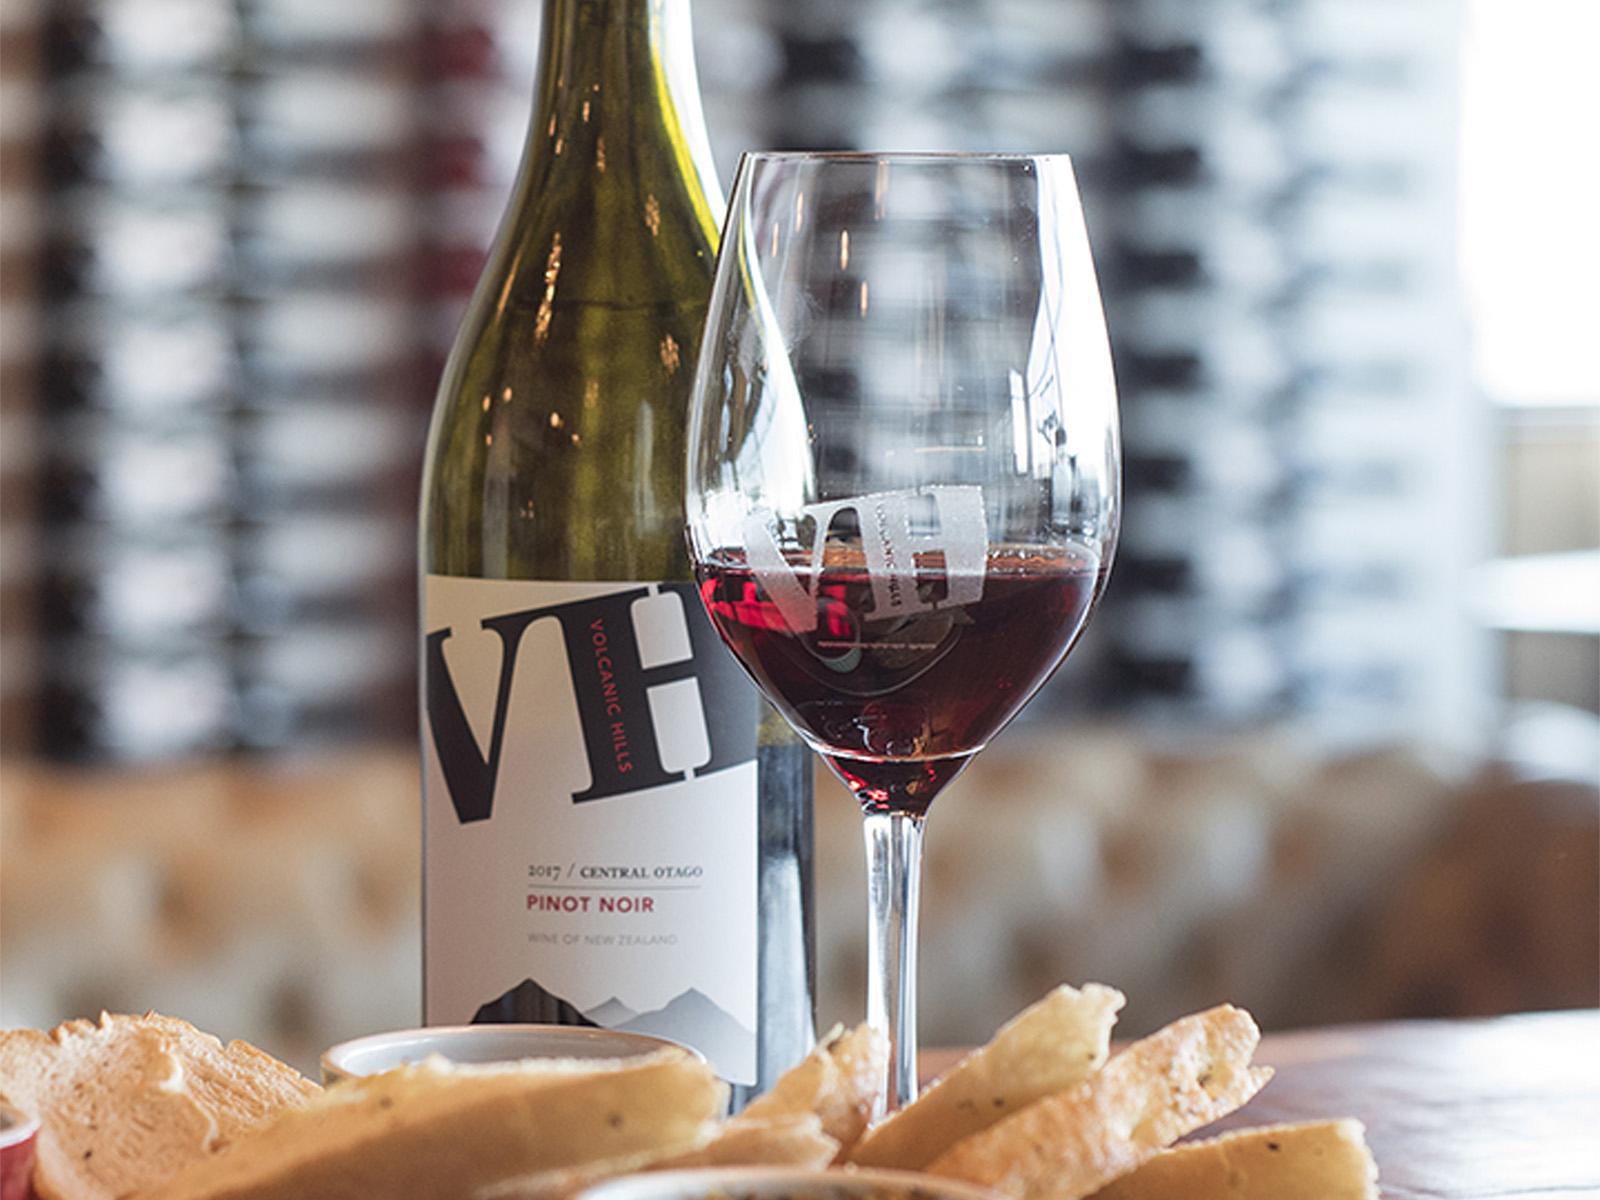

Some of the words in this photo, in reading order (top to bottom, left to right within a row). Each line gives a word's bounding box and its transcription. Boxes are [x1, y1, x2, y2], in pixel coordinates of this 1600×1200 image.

[426, 578, 758, 825] VH
[590, 618, 622, 716] VOLCANIC
[609, 721, 634, 774] HILLS
[527, 864, 562, 881] 2017
[579, 865, 650, 879] CENTRAL
[653, 865, 704, 879] OTAGO
[526, 894, 591, 912] PINOT
[599, 896, 655, 913] NOIR
[527, 932, 558, 945] WINE
[561, 933, 581, 946] OF
[584, 934, 616, 946] NEW
[617, 934, 679, 946] ZEALAND
